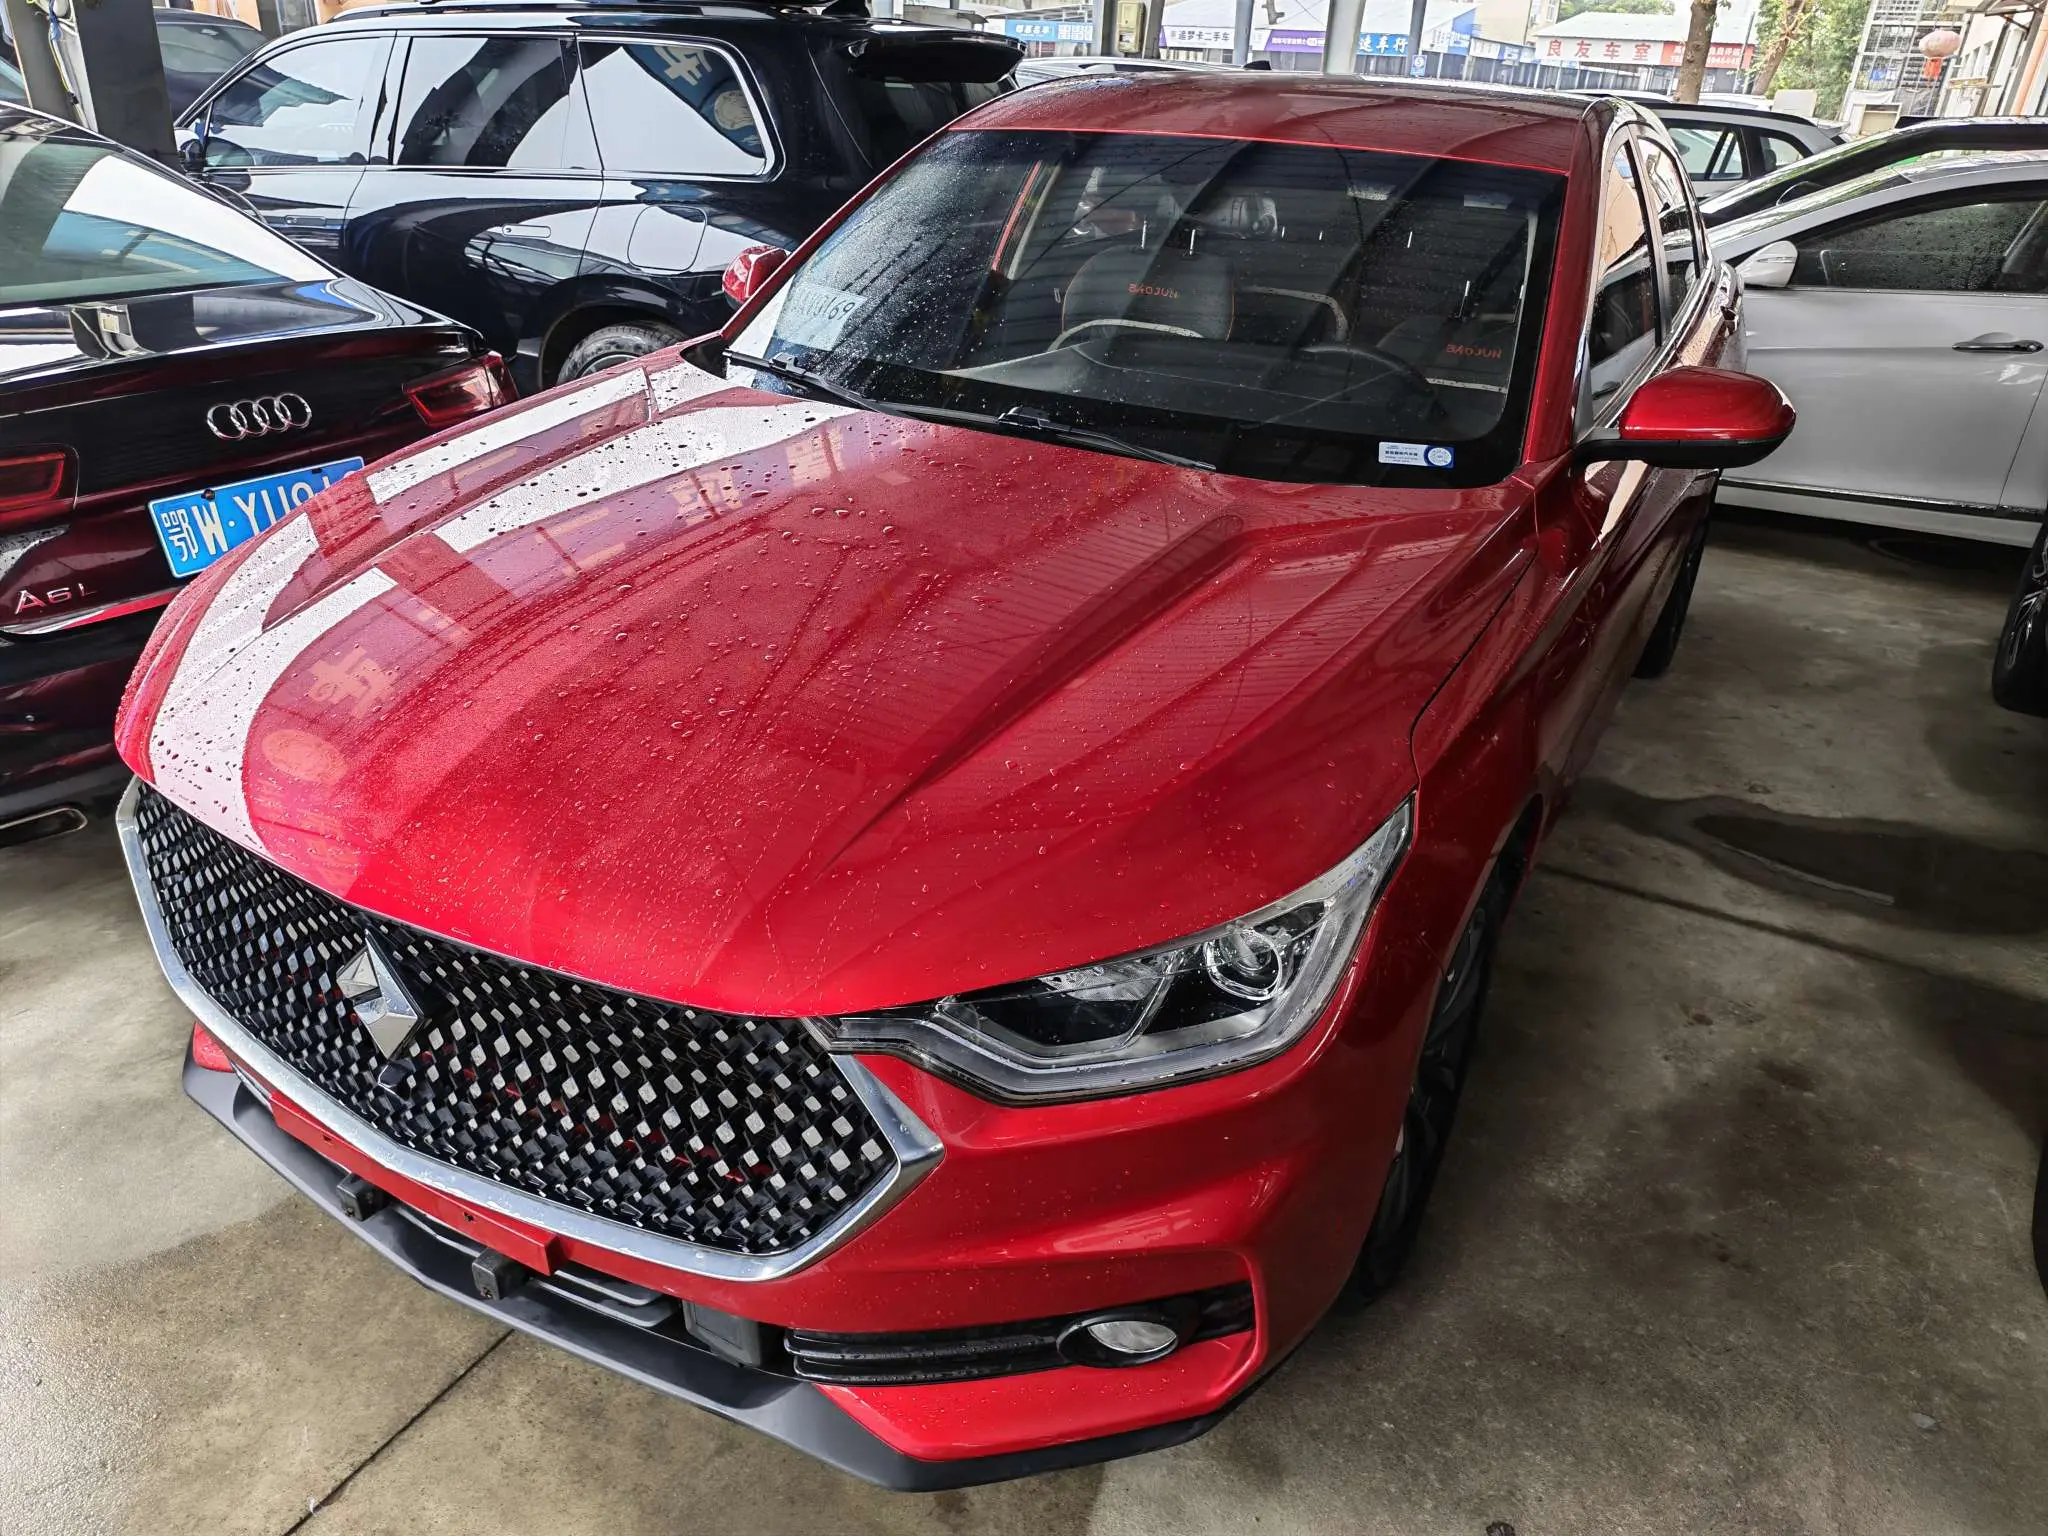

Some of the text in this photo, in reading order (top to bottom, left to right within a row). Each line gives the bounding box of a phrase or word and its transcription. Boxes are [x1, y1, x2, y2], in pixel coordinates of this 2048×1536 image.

[1547, 39, 1652, 61] 良友车室
[1128, 282, 1180, 298] BAOJUN
[1446, 343, 1503, 359] BAOJUN
[14, 582, 96, 615] A6L
